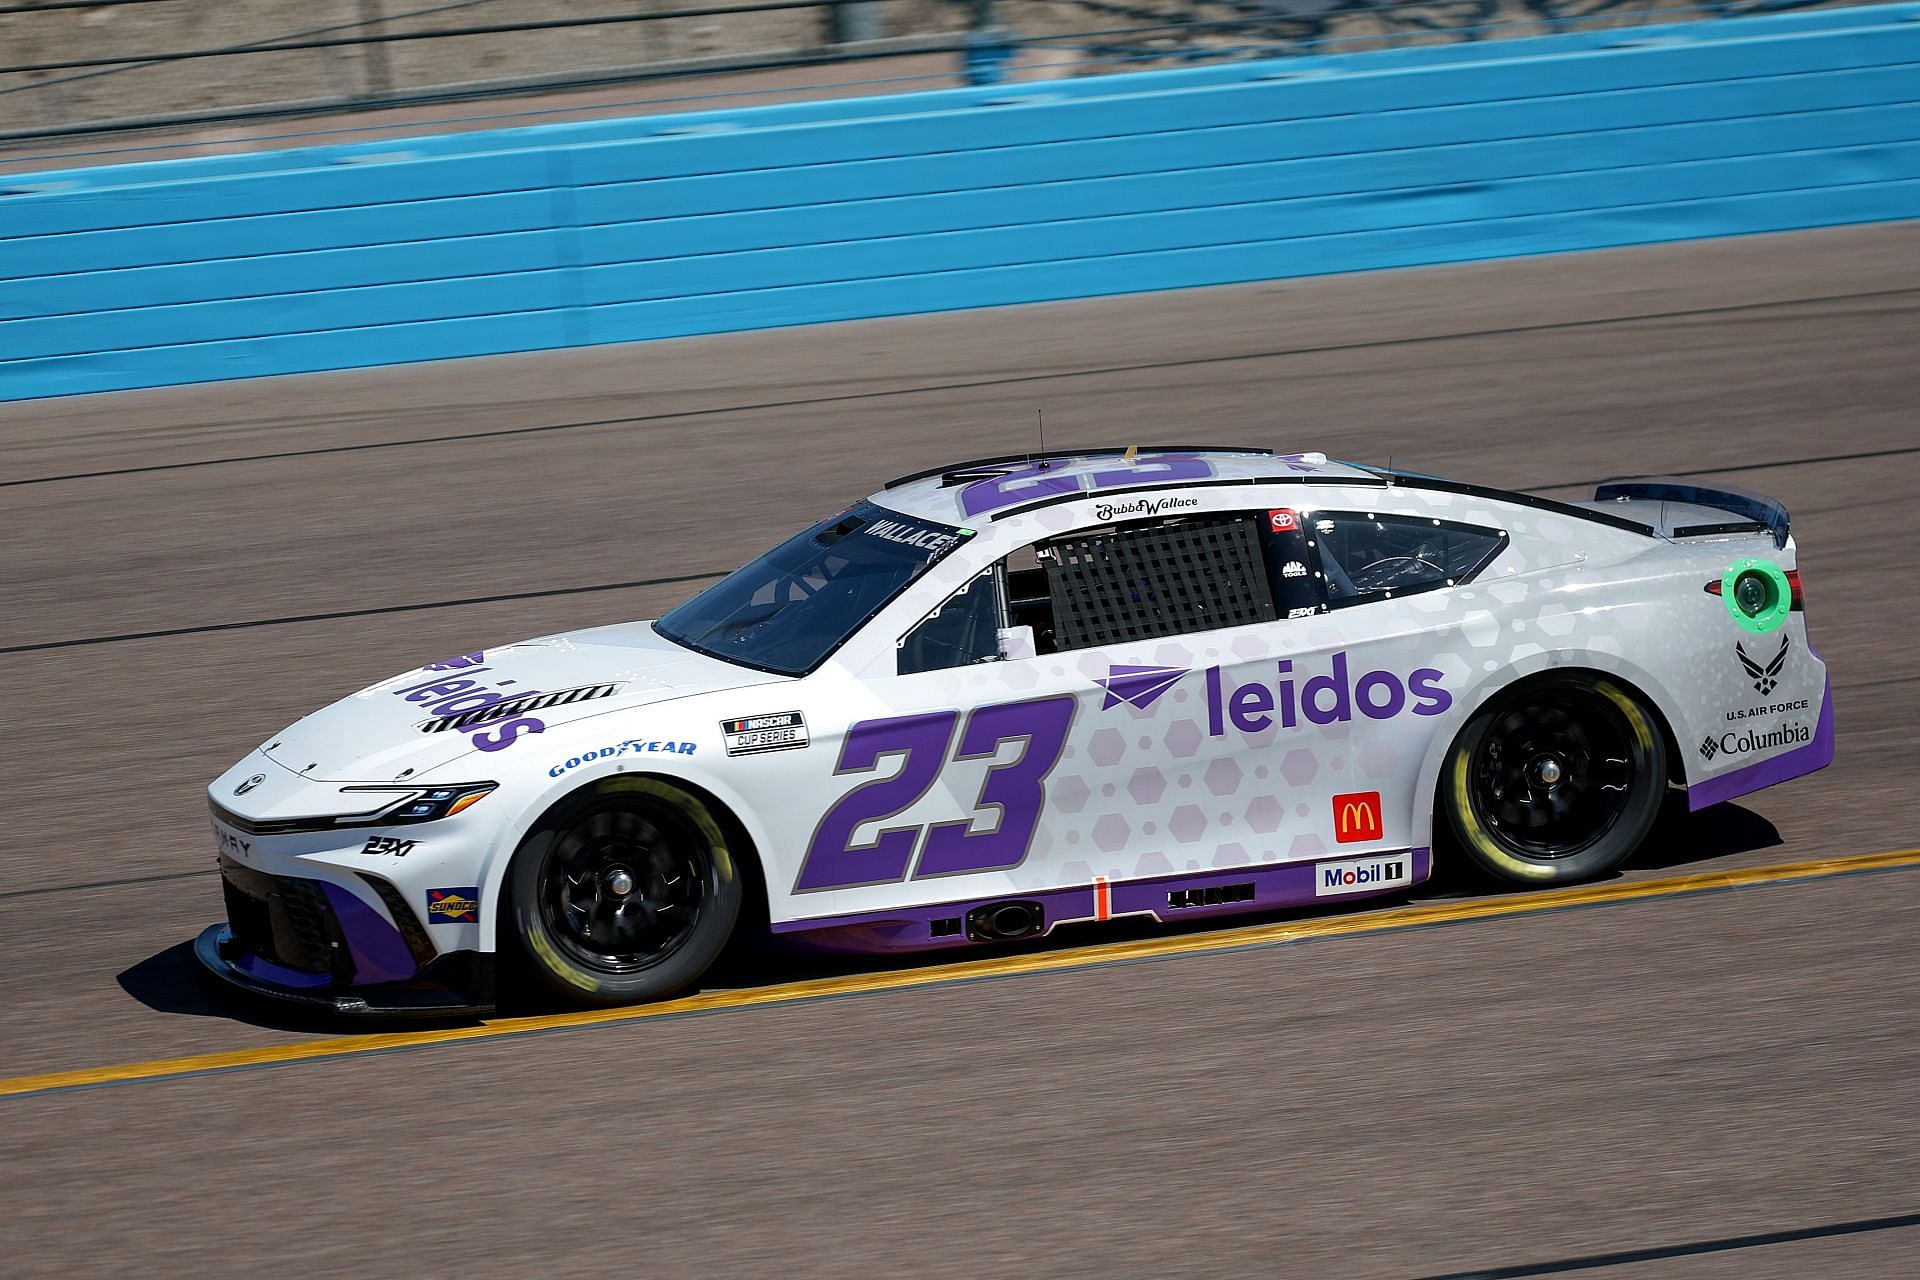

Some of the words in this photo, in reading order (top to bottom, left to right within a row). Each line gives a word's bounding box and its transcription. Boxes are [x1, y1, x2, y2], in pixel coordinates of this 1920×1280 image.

[1139, 498, 1198, 515] Wallace
[864, 519, 953, 550] WALLACE
[1206, 651, 1453, 736] leidos
[1726, 711, 1747, 720] U.S.
[1748, 706, 1767, 717] AIR
[1769, 699, 1809, 714] FORCE
[748, 715, 792, 730] NASCAR
[737, 734, 758, 746] CUP
[759, 729, 796, 743] SERIES
[1720, 722, 1810, 754] Columbia
[548, 740, 698, 778] GOODYEAR
[791, 694, 1079, 896] 23
[1325, 864, 1381, 887] Mobil
[1388, 863, 1399, 879] 1
[430, 901, 477, 913] SUNOCO
